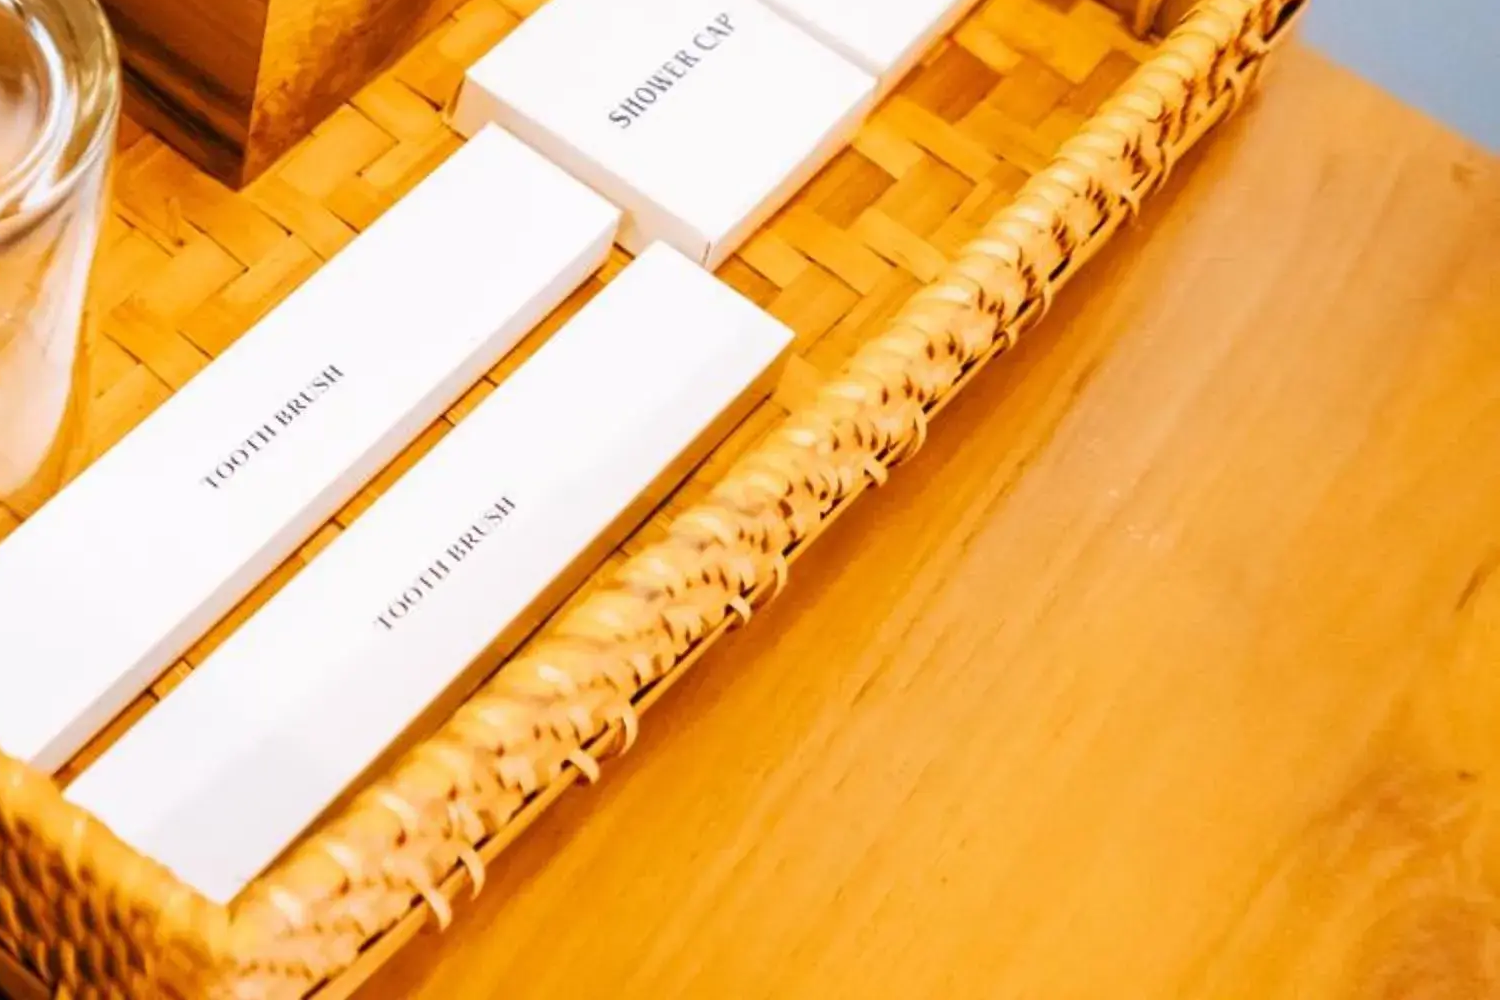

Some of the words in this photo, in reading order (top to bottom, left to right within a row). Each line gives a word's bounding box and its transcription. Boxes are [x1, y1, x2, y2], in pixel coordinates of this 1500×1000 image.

[608, 49, 700, 129] SHOWER
[693, 12, 735, 51] CAP
[201, 423, 277, 489] TOOTH
[274, 364, 345, 427] BRUSH
[374, 559, 450, 631] TOOTH
[446, 495, 516, 562] BRUSH
